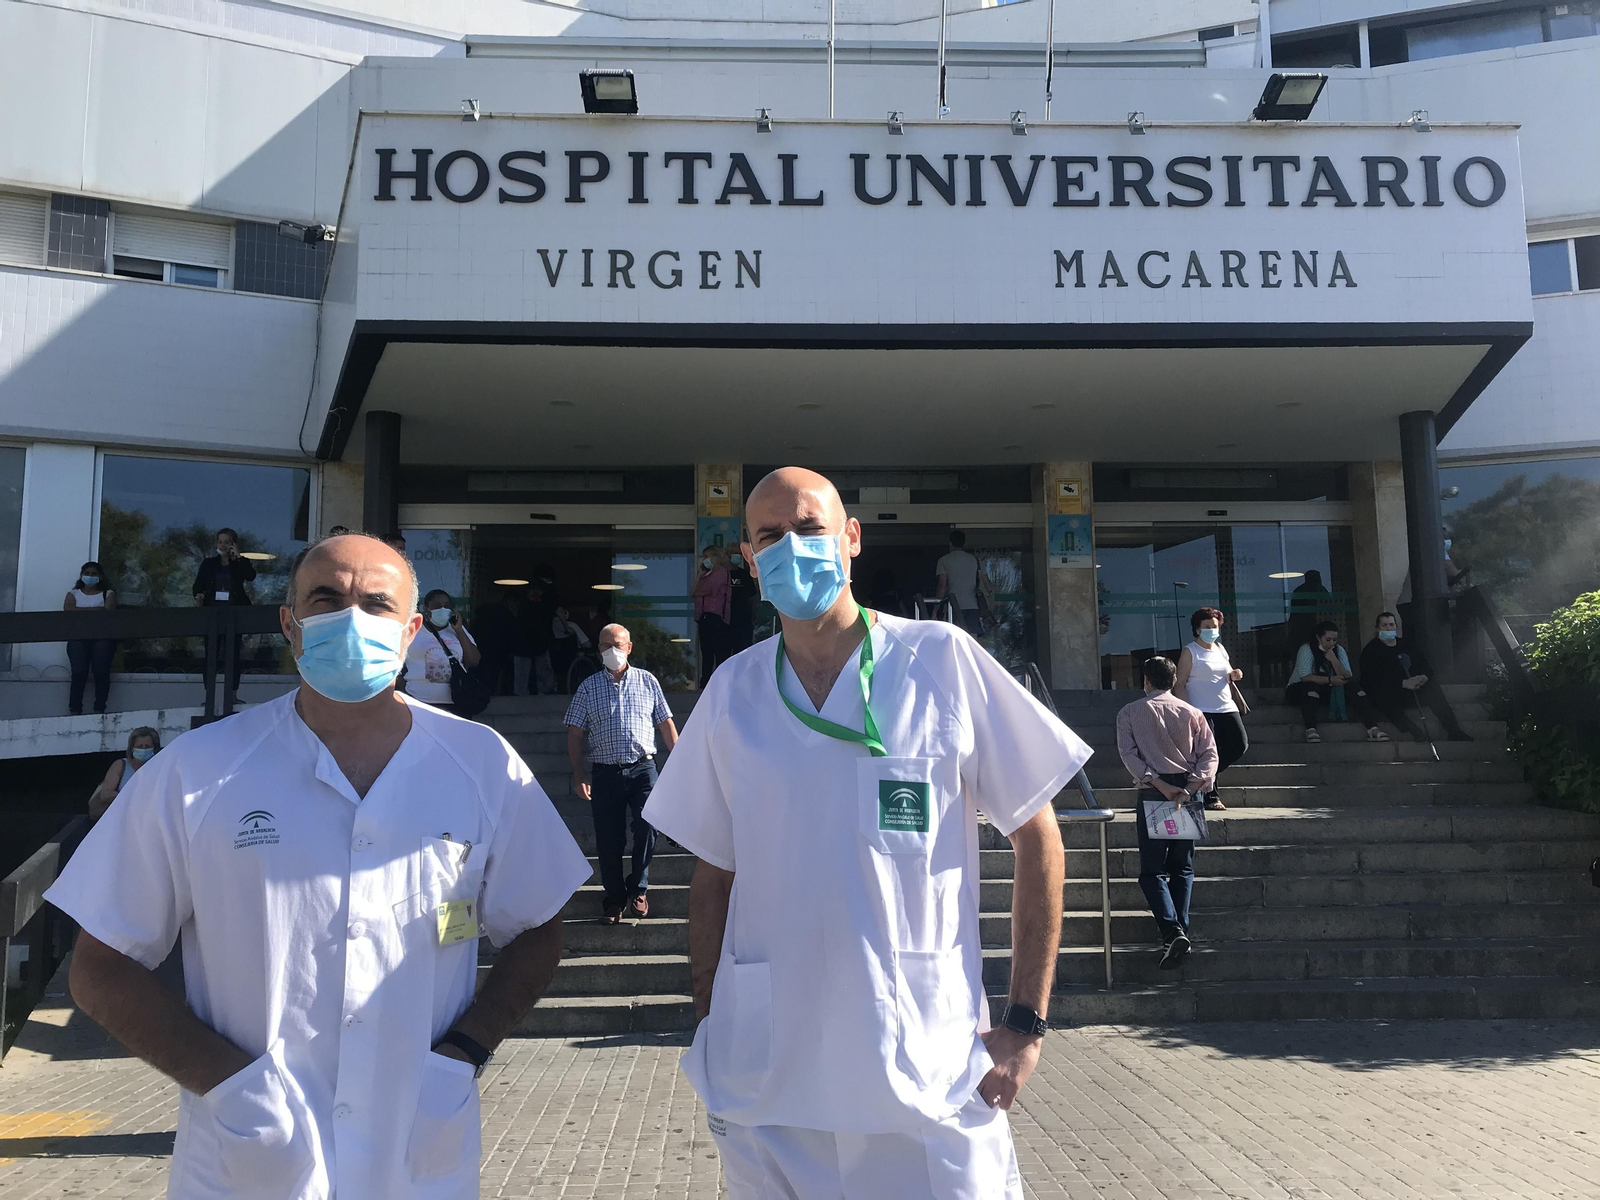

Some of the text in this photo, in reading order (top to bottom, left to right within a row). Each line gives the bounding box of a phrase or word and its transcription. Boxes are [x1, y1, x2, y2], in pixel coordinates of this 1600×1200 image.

[374, 148, 1507, 208] HOSPITAL UNIVERSITARIO
[536, 248, 1357, 289] VIRGEN MACARENA
